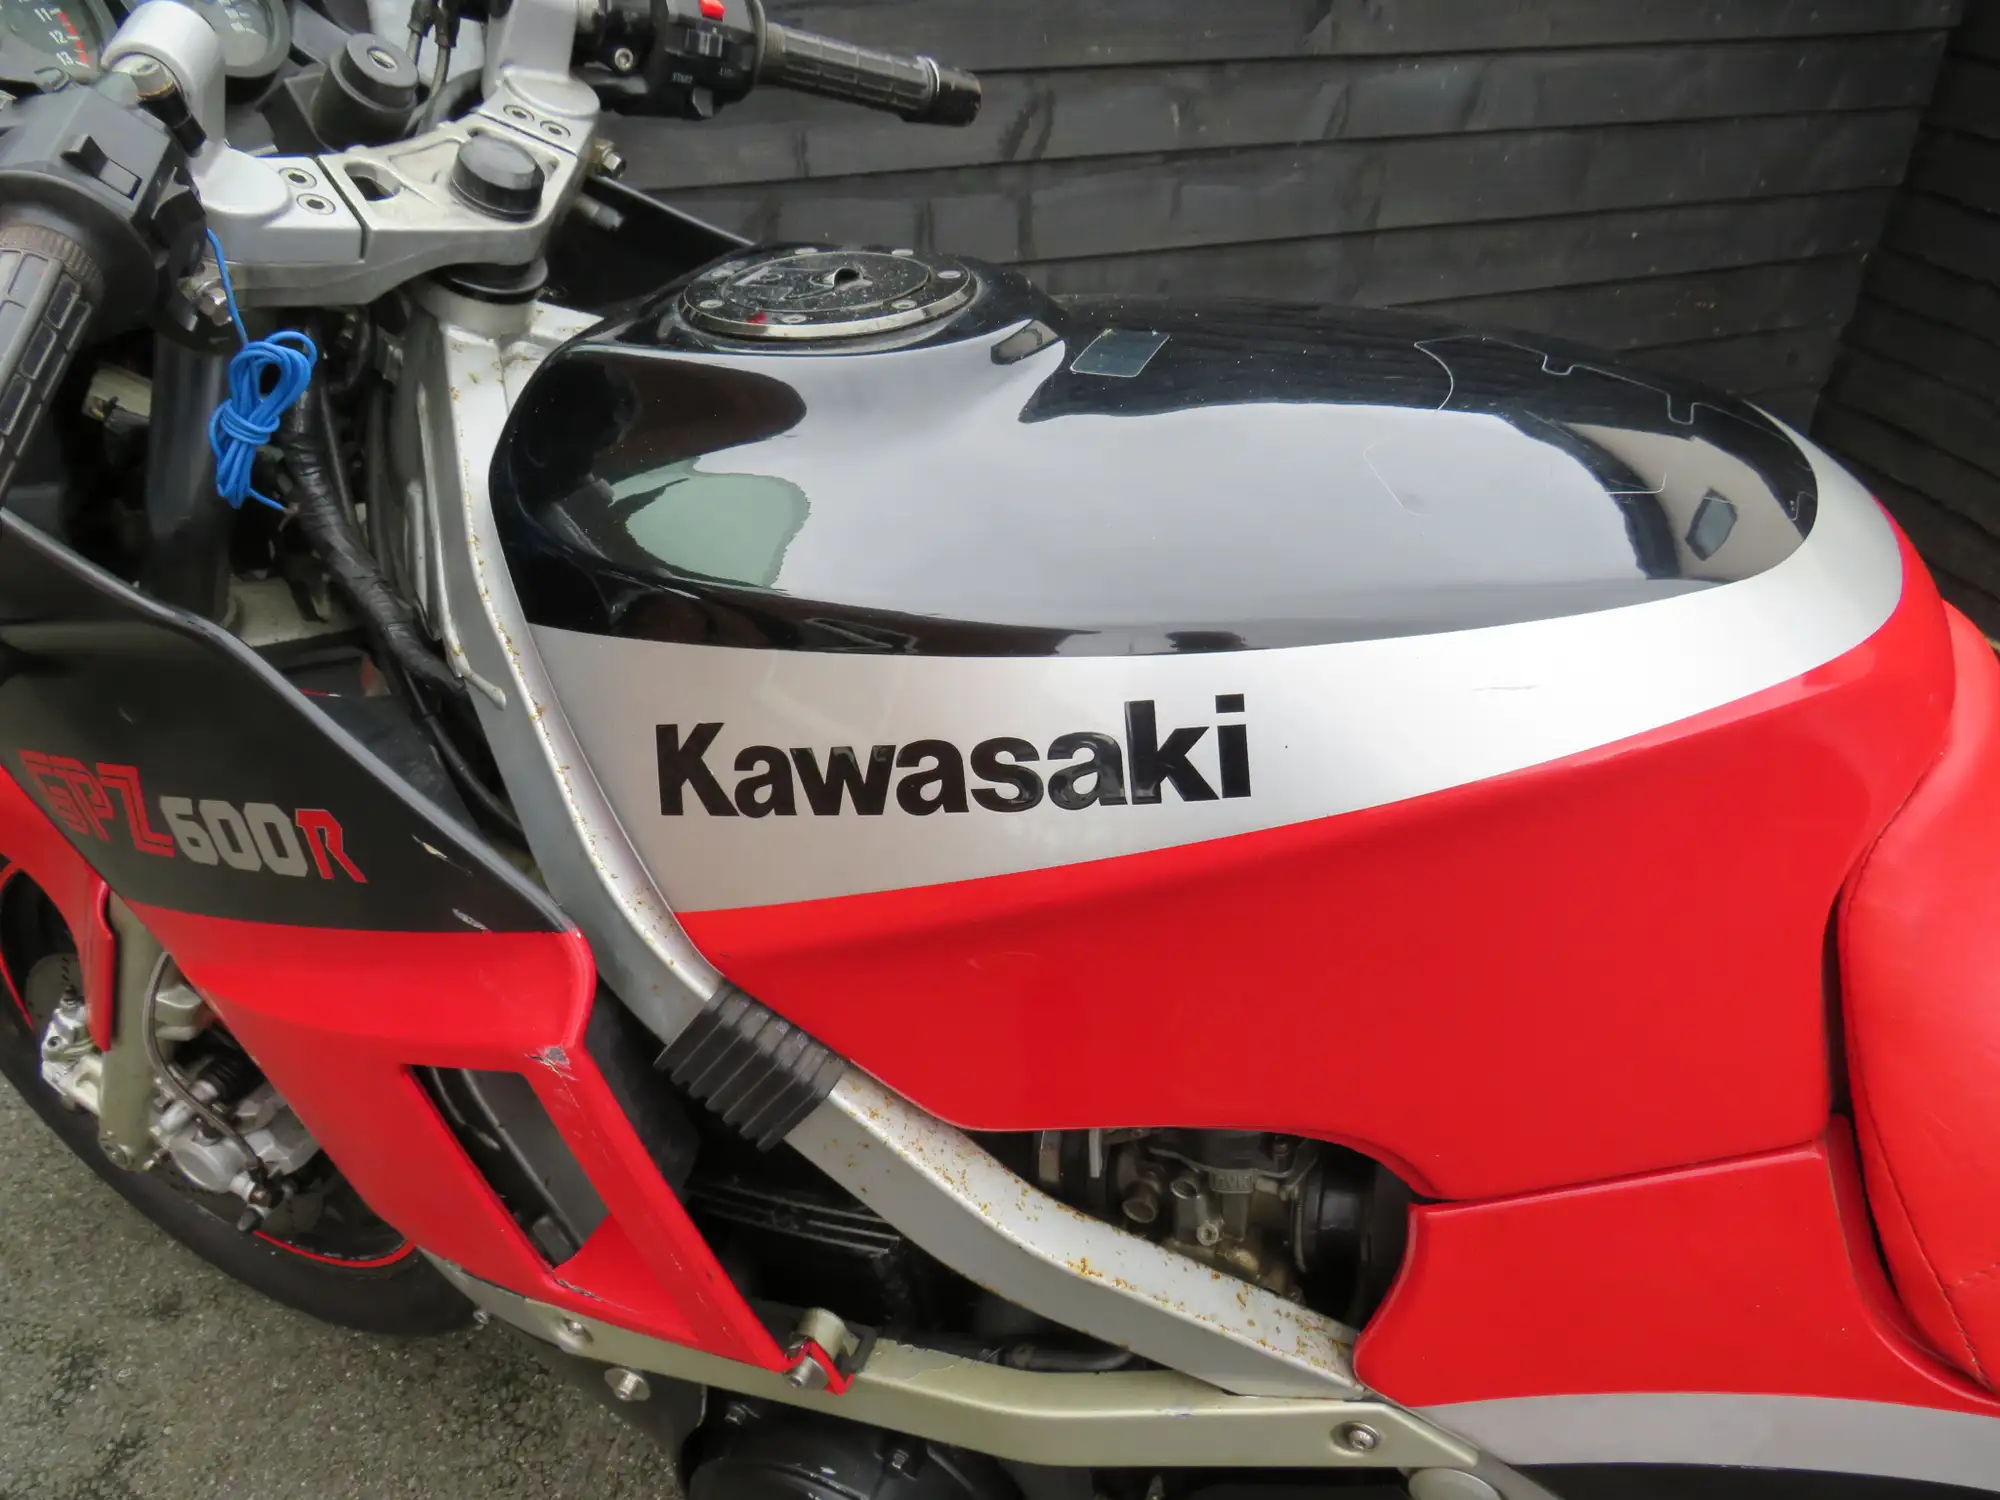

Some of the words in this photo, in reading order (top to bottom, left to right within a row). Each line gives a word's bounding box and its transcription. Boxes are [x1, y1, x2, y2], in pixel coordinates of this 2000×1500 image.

[48, 29, 69, 44] 12
[55, 50, 74, 66] 13
[655, 693, 1252, 817] Kawasaki
